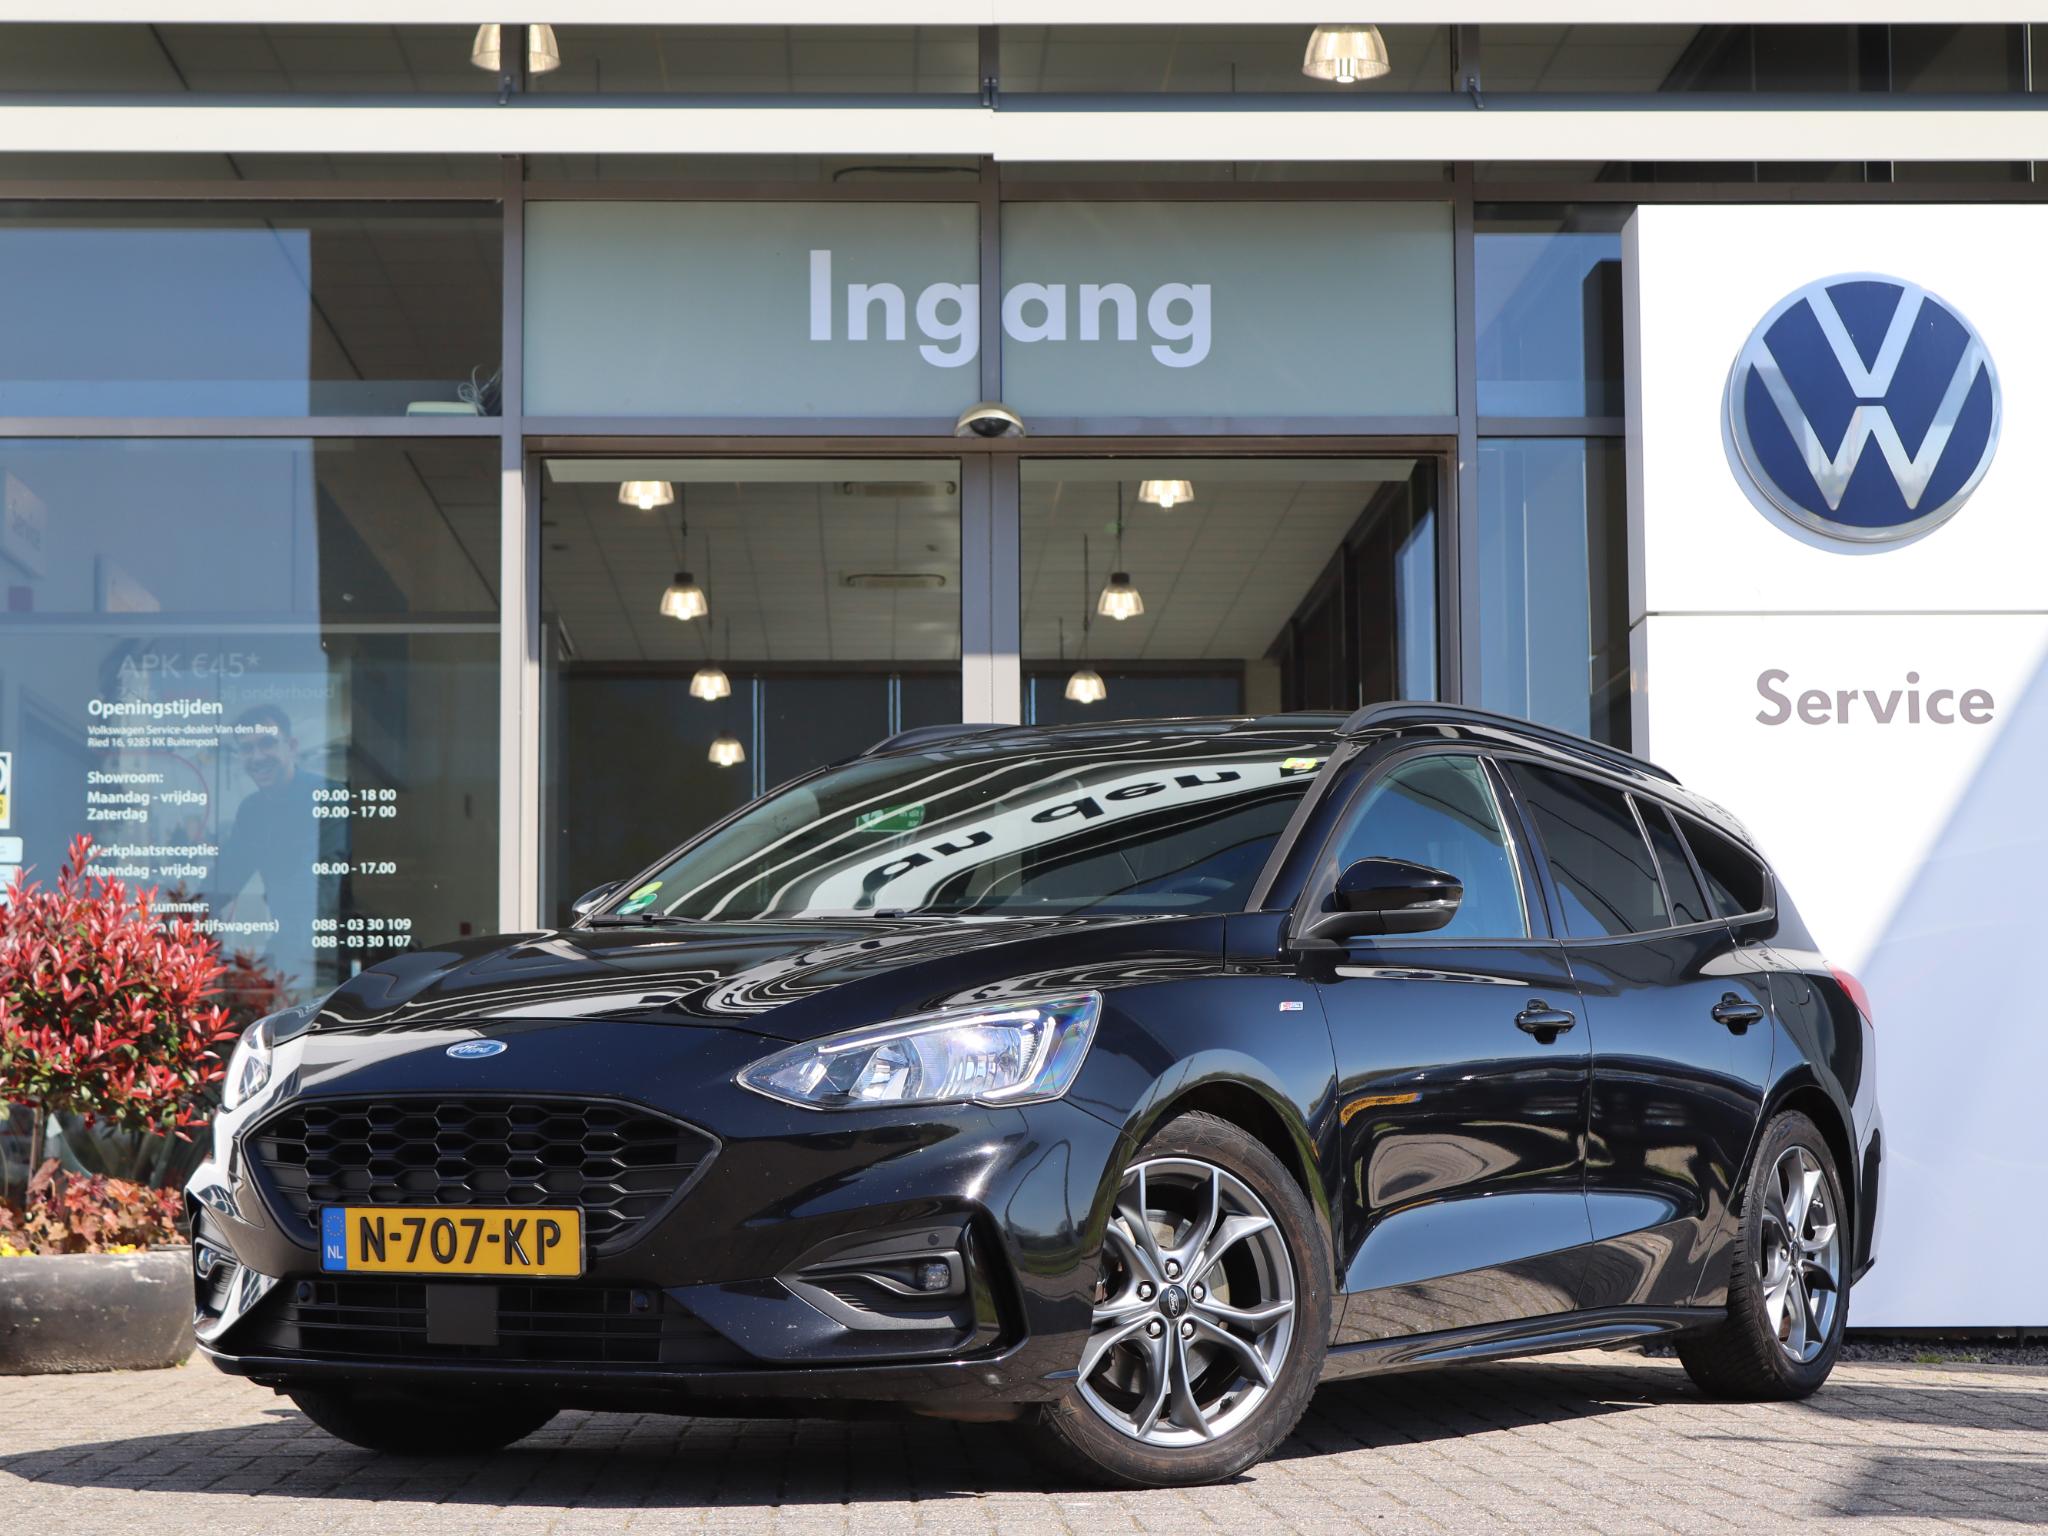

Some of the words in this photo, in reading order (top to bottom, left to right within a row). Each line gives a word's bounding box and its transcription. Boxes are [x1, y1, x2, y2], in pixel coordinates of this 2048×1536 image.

[809, 249, 1212, 368] Ingang
[117, 654, 186, 679] APK
[1755, 668, 1996, 727] Service
[87, 698, 223, 719] Openingstijden
[87, 725, 145, 736] Volkswagen
[146, 725, 213, 735] Service-dealer
[214, 724, 234, 734] Van
[234, 724, 254, 734] den
[254, 724, 279, 736] Brug
[87, 737, 110, 748] Ried
[151, 737, 166, 747] KK
[166, 737, 219, 748] Buitenpost
[87, 771, 164, 784] Showroom:
[87, 791, 150, 806] Maandag
[160, 790, 208, 806] vrijdag
[312, 789, 350, 801] 09.00
[87, 807, 148, 823] Zaterdag
[312, 805, 350, 818] 09.00
[86, 864, 150, 880] Maandag
[160, 863, 208, 879] vrijdag
[312, 862, 350, 875] 08.00
[360, 861, 397, 875] 17.00
[312, 918, 338, 931] 088
[346, 918, 365, 931] 03
[366, 918, 385, 931] 30
[387, 918, 412, 931] 109
[312, 935, 338, 948] 088
[346, 935, 365, 948] 03
[366, 935, 385, 948] 30
[387, 935, 412, 947] 107
[359, 1216, 561, 1266] N-707-KP
[326, 1245, 344, 1260] NL
